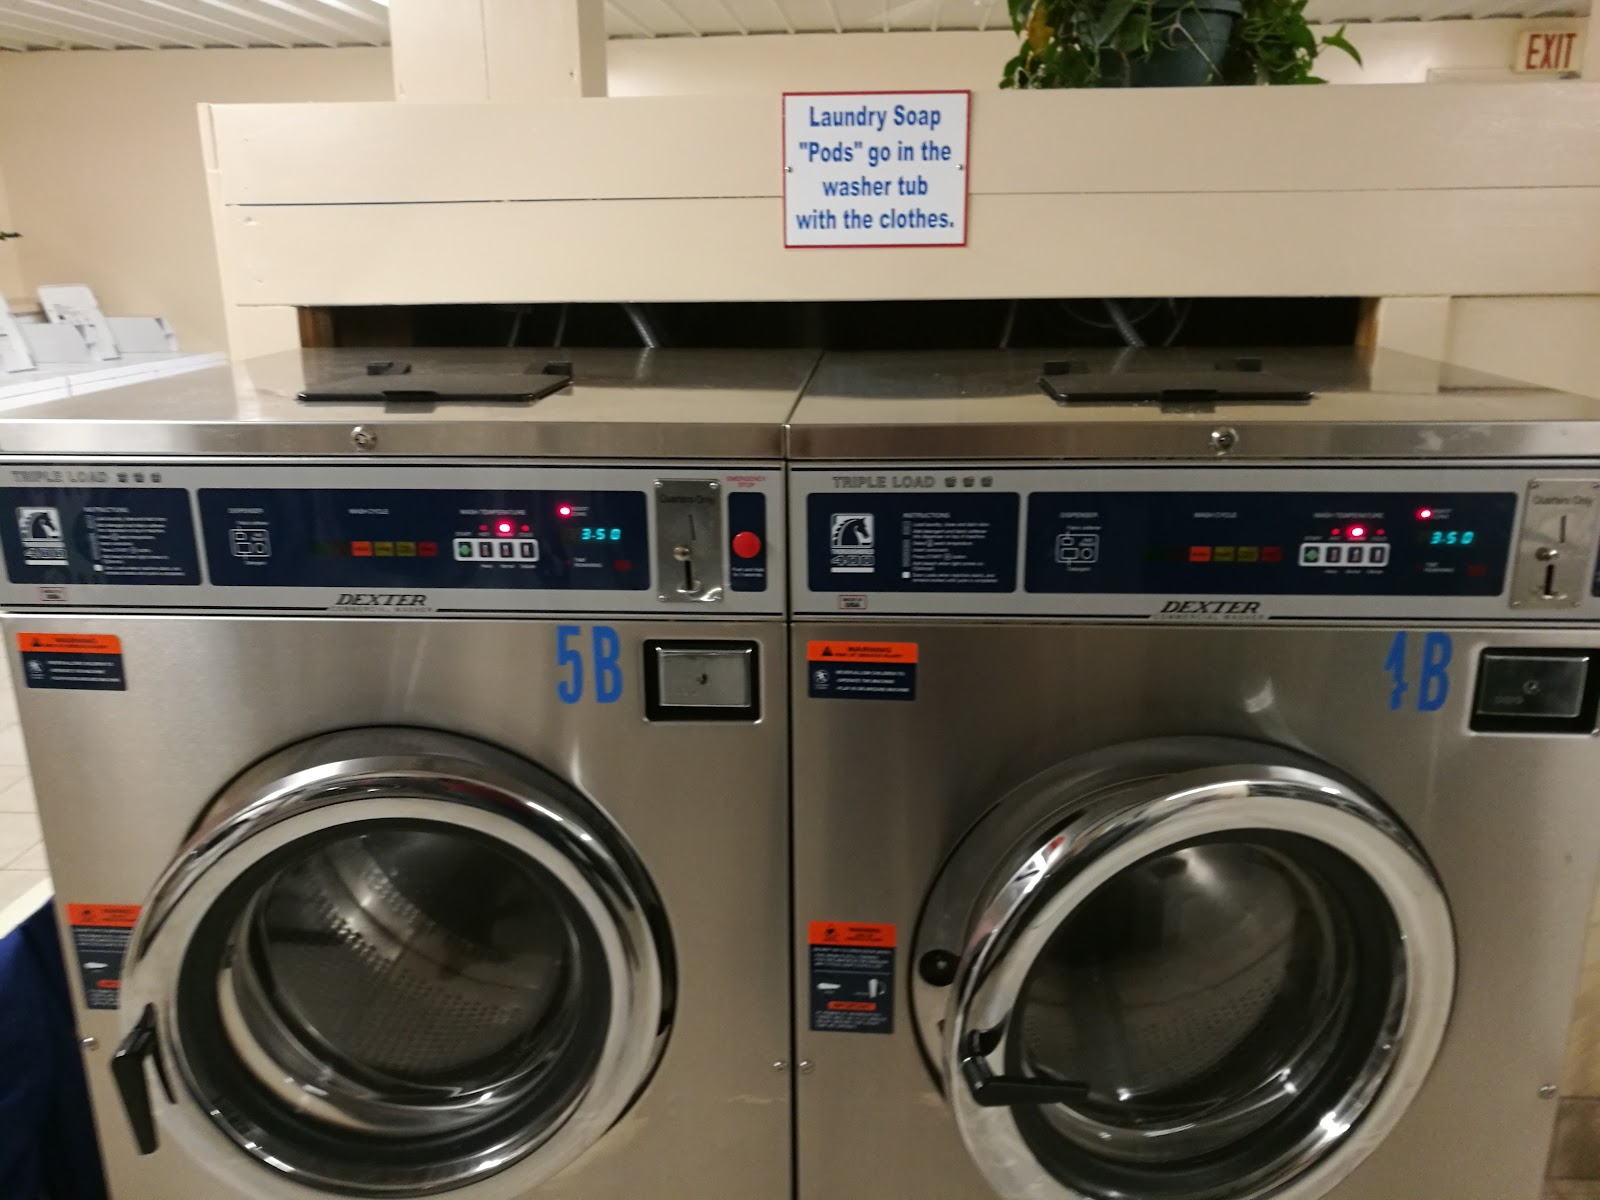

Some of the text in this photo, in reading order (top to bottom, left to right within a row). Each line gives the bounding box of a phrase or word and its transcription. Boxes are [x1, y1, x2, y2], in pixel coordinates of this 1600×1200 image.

[1525, 33, 1578, 70] EXIT
[809, 104, 941, 132] Laundry Soap
[799, 140, 952, 168] "Pods" go in the
[822, 175, 928, 197] washer tub
[796, 208, 955, 230] with the clothes.
[11, 471, 110, 483] TRIPLE LOAD
[832, 476, 936, 488] TRIPLE LOAD
[335, 593, 427, 606] DEXTER
[1160, 600, 1261, 614] DEXTER
[556, 625, 623, 705] 5B
